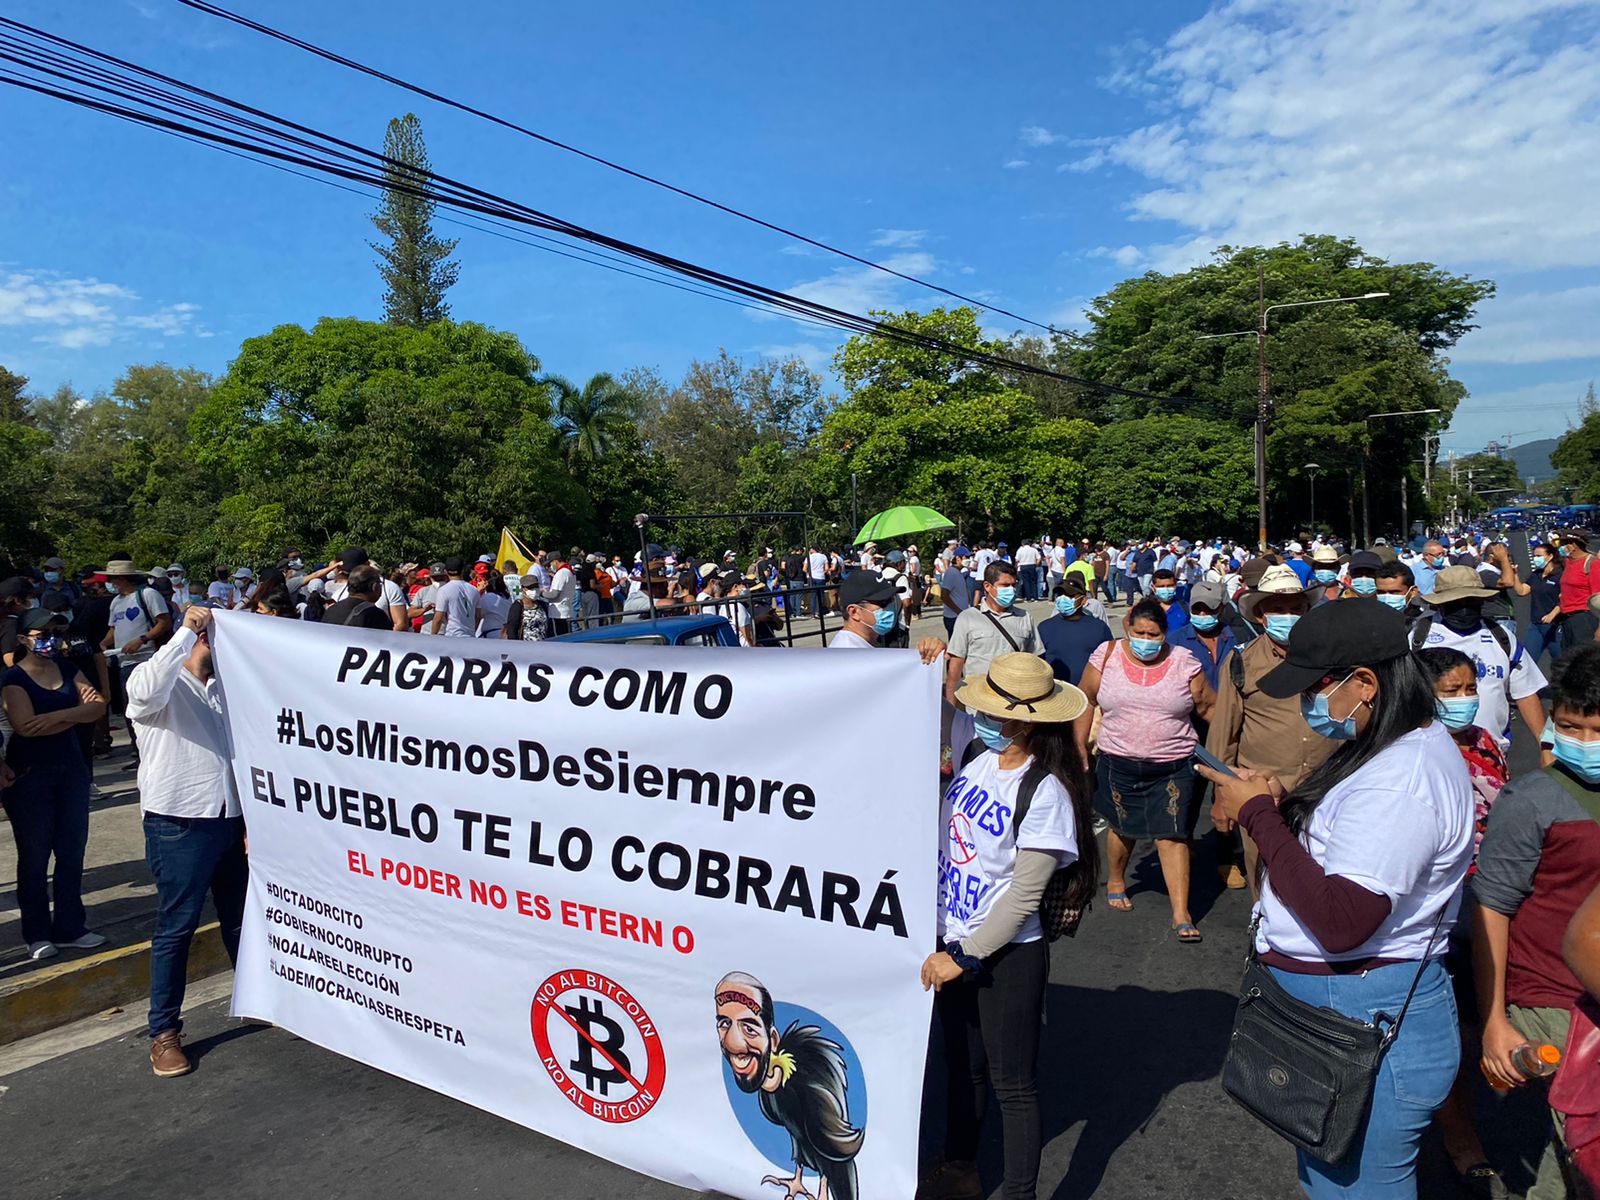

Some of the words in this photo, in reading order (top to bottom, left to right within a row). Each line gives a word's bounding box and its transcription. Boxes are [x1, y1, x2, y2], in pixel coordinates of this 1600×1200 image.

[336, 646, 555, 703] PAGARÁS
[276, 707, 816, 823] #LosMismosDeSiempre
[977, 799, 1012, 837] ES
[250, 766, 287, 808] EL
[293, 777, 439, 844] PUEBLO
[453, 808, 512, 859] TE
[528, 820, 593, 872] LO
[611, 835, 909, 939] COBRARÁ
[266, 881, 363, 930] #DICTADORCITO
[347, 850, 375, 877] EL
[381, 858, 463, 899] PODER
[469, 879, 507, 910] NO
[516, 890, 552, 921] ES
[265, 906, 413, 973] #GOBIERNOCORRUPTO
[267, 933, 400, 997] #NOALAREELECCIÓN
[269, 958, 466, 1047] #LADEMOCRACIASERESPETA
[536, 983, 556, 1007] NO
[559, 973, 580, 988] AL
[586, 973, 655, 1038] BITCOIN
[715, 991, 761, 1015] DICTADOR
[544, 1057, 565, 1083] NO
[565, 1087, 586, 1109] AL
[592, 1089, 655, 1120] BITCOIN
